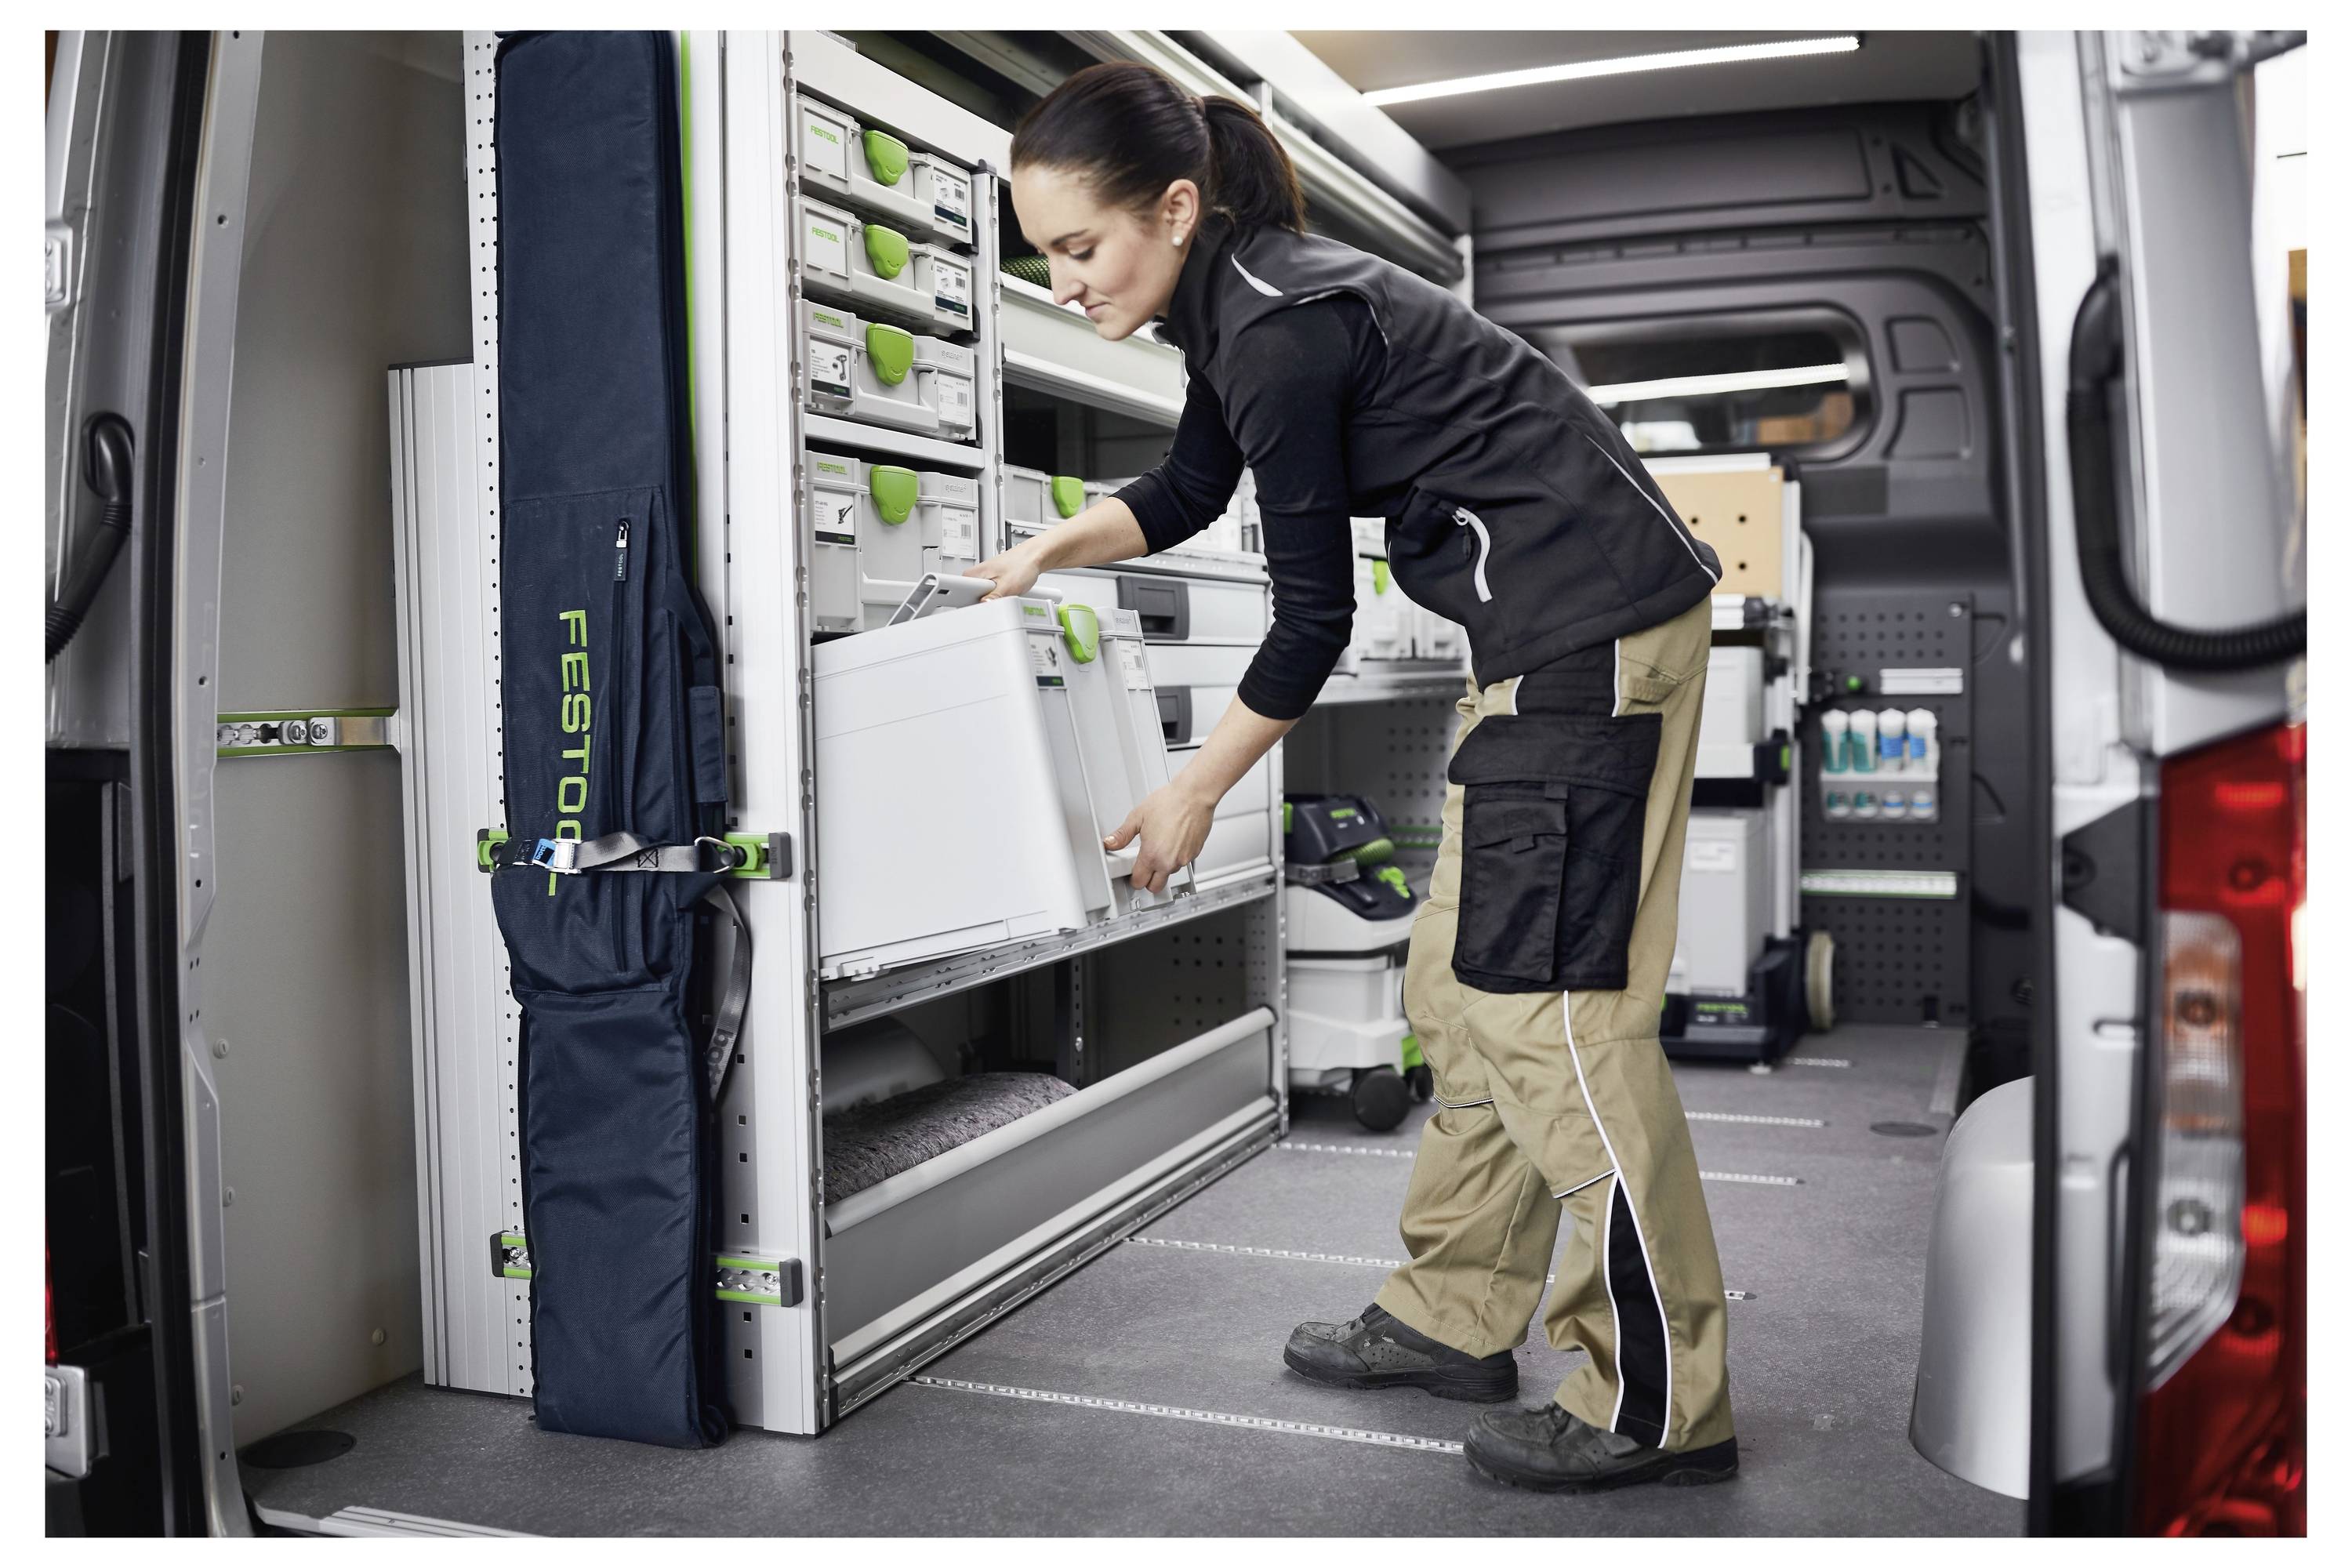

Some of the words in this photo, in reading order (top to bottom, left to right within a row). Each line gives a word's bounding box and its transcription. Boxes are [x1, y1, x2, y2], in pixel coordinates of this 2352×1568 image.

[810, 125, 839, 144] FESTOOL
[811, 226, 840, 243] FESTOOL
[535, 844, 547, 860] bott
